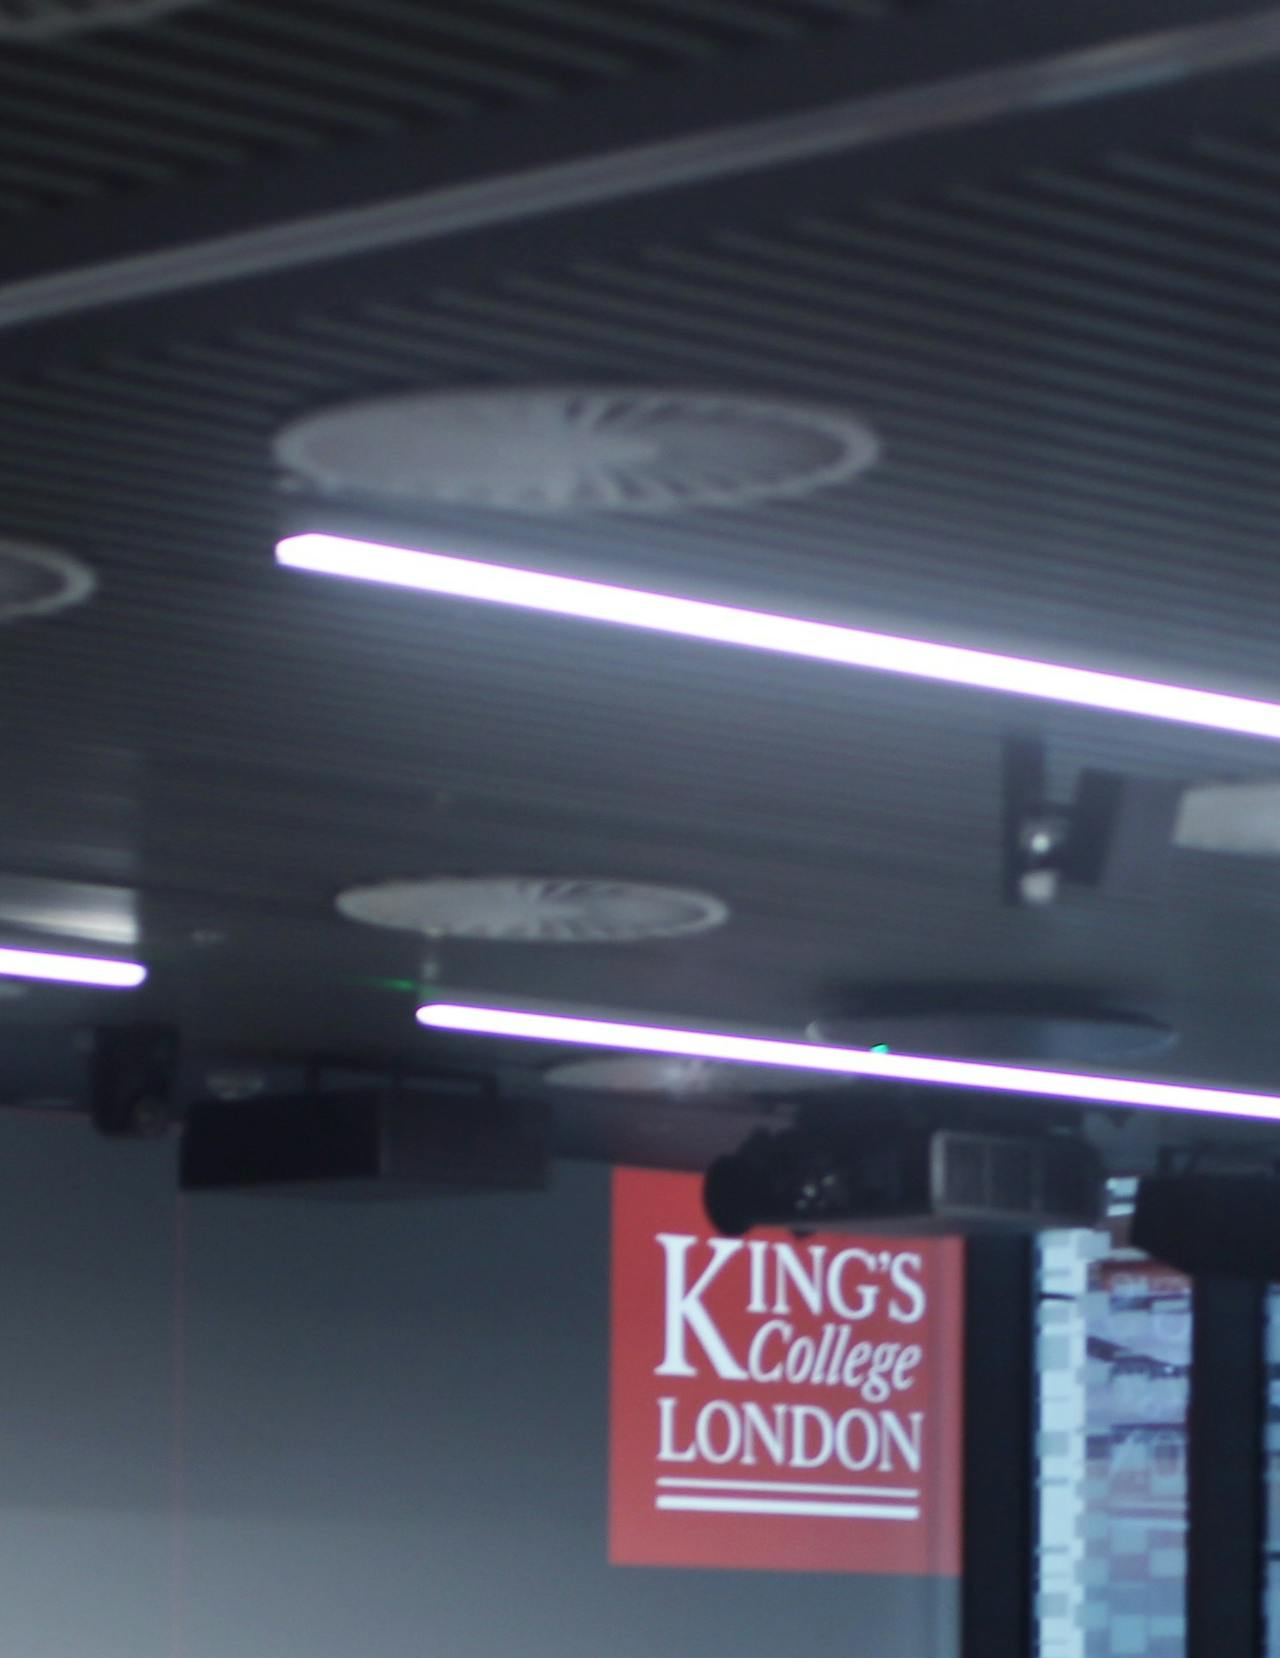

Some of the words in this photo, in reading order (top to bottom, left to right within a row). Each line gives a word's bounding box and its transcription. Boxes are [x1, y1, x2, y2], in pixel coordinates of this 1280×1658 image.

[654, 1233, 926, 1381] KING'S
[749, 1319, 922, 1403] College
[657, 1397, 925, 1473] LONDON
